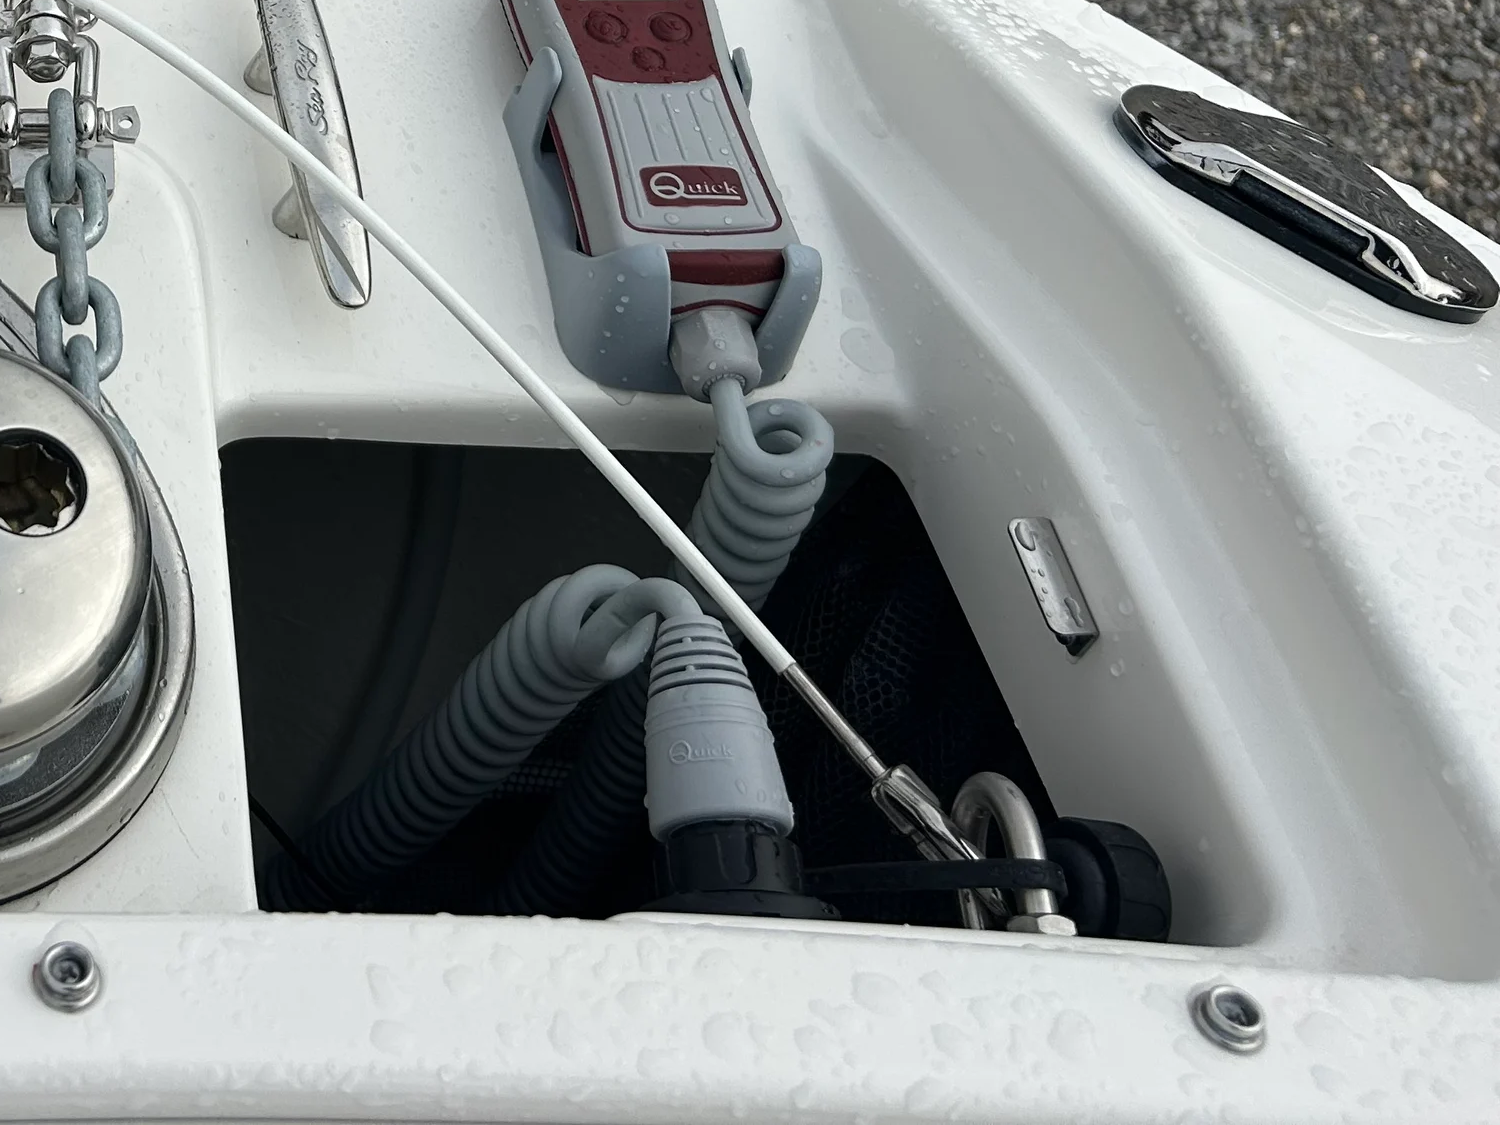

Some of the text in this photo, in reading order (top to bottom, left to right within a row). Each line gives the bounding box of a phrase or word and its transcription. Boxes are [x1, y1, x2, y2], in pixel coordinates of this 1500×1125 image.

[295, 39, 328, 136] Sea Ray
[649, 172, 741, 200] Quick
[669, 740, 735, 764] Quick
